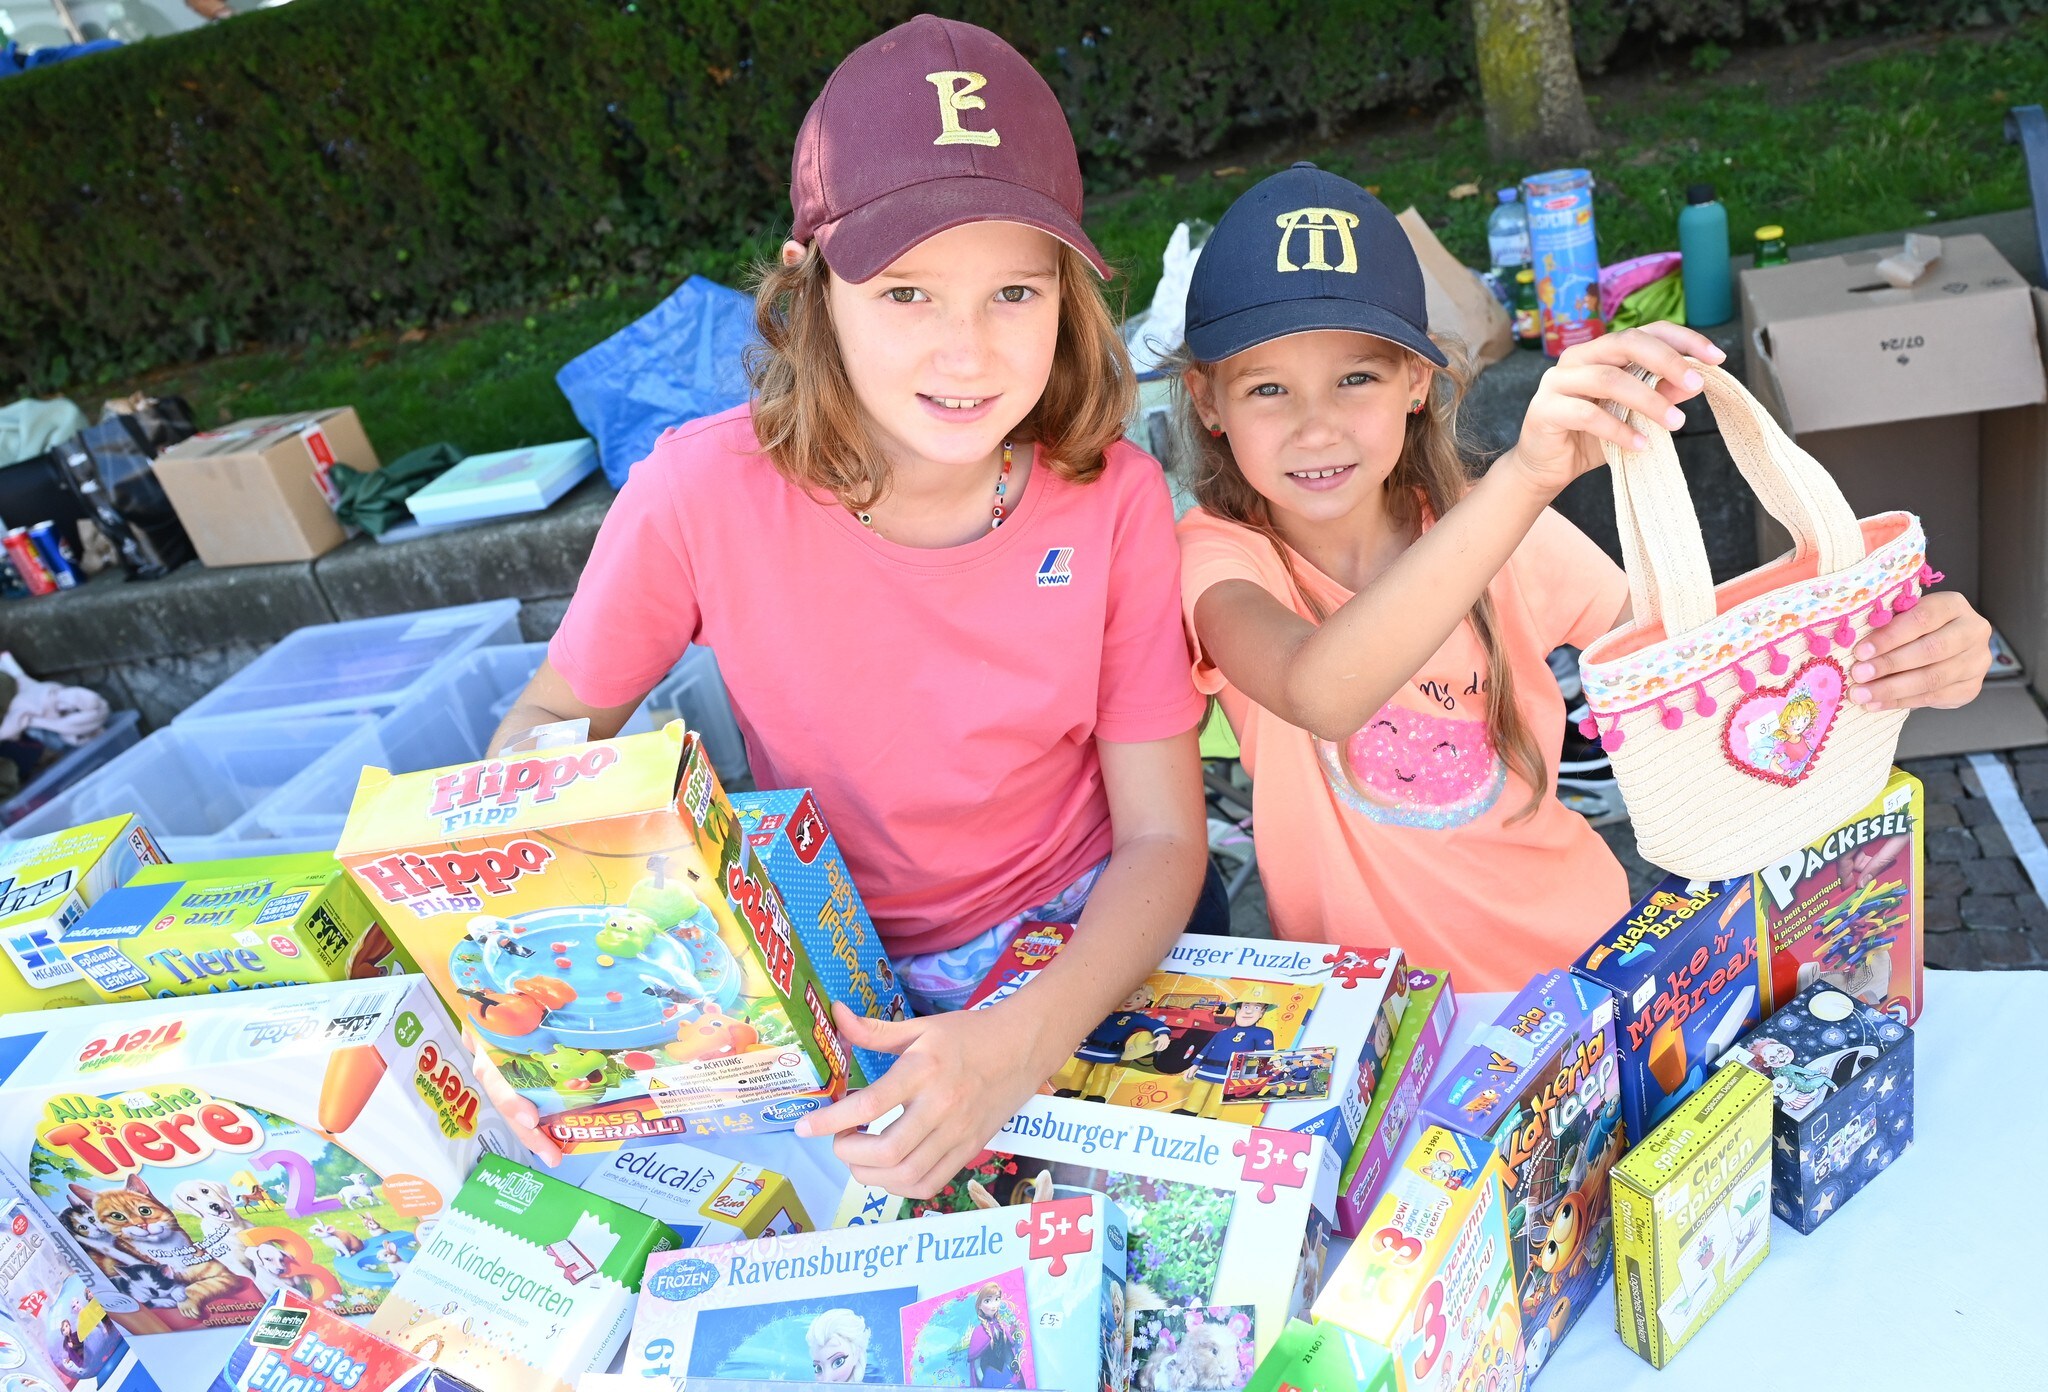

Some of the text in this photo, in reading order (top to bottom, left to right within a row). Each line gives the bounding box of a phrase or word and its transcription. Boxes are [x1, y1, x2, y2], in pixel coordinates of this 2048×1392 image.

[430, 747, 620, 816] Hippo
[444, 805, 518, 832] Flipp
[358, 840, 553, 902] Hippo
[1760, 813, 1907, 911] PACKESEL
[181, 881, 277, 910] füttern
[264, 902, 301, 916] NEUES
[267, 893, 308, 907] LERNEN
[409, 896, 482, 917] Flipp
[822, 857, 867, 948] der Käfer
[1772, 877, 1842, 930] Le petit Bourriquot
[184, 908, 237, 927] Tiere
[261, 908, 297, 923] spielend
[726, 861, 796, 1000] Hippo
[766, 887, 791, 945] Flipp
[1611, 903, 1661, 953] Make
[1647, 888, 1719, 941] Break
[1779, 914, 1808, 939] piccolo
[1807, 899, 1829, 918] Asino
[66, 925, 142, 938] Ravensburger
[273, 939, 290, 949] 3-6
[1024, 935, 1063, 945] FIREMAN
[1774, 923, 1813, 954] Pack Mule
[79, 947, 117, 967] spielend
[1020, 942, 1057, 957] SAM
[1237, 947, 1311, 970] Puzzle
[32, 962, 75, 981] MEGABLEU
[86, 958, 131, 978] NEUES
[100, 969, 142, 989] LERNEN
[145, 948, 265, 985] Tiere
[1409, 975, 1431, 989] 4+
[1572, 978, 1588, 1011] Ravensburger
[1626, 945, 1711, 1052] Make
[1671, 936, 1759, 1031] Break
[80, 1021, 183, 1062] Tiere
[398, 1017, 415, 1039] 3-4
[79, 1054, 124, 1072] meine
[703, 1057, 744, 1070] ACHTUNG:
[811, 1026, 841, 1080] SPASS
[1504, 1083, 1515, 1094] Das
[1535, 1027, 1566, 1059] Käfer-Rennen
[418, 1045, 478, 1134] Tiere
[668, 1086, 713, 1098] ATTENTION:
[748, 1070, 795, 1084] AVVERTENZA:
[49, 1087, 202, 1123] Alle meine
[415, 1073, 460, 1138] Alle meine
[766, 1099, 816, 1116] Hasbro
[1499, 1029, 1605, 1194] Kakerla
[1700, 1075, 1740, 1115] Logisches Denken
[554, 1119, 681, 1141] ÜBERALL!
[563, 1111, 637, 1127] SPASS
[689, 1118, 712, 1126] ALTER
[696, 1125, 717, 1135] 4+
[43, 1104, 254, 1175] Tiere
[1001, 1111, 1219, 1166] ensburger Puzzle
[1252, 1138, 1288, 1170] 3+
[1424, 1136, 1440, 1155] 23 390
[1649, 1126, 1676, 1154] Clever
[1653, 1127, 1695, 1172] spielen
[615, 1151, 715, 1193] educal toy
[1692, 1127, 1743, 1187] Clever
[603, 1171, 691, 1205] Lerne das Zählen Learn to count
[1516, 1182, 1524, 1198] Das
[1676, 1137, 1753, 1231] spielen
[1691, 1157, 1754, 1232] Logisches Denken
[714, 1195, 745, 1208] Bino
[1038, 1211, 1072, 1246] 5+
[1413, 1207, 1432, 1237] vince!
[1424, 1226, 1432, 1239] op
[1429, 1211, 1441, 1228] een
[1622, 1199, 1634, 1243] spielen
[1634, 1216, 1645, 1247] Clever
[148, 1223, 231, 1259] Wie viele Tierkinder
[182, 1243, 231, 1267] siehst du?
[728, 1225, 1003, 1286] Ravensburger Puzzle
[1372, 1228, 1423, 1265] 3
[427, 1231, 574, 1318] Im Kindergarten
[1413, 1179, 1492, 1380] 3 gewinnt!
[1444, 1225, 1483, 1303] gagnant!
[412, 1265, 529, 1328] Lernkompetenzen kindgemäß anbahnen
[655, 1272, 712, 1292] FROZEN
[1447, 1256, 1477, 1318] vince!
[25, 1293, 43, 1310] 72
[1451, 1307, 1463, 1328] op
[1459, 1272, 1480, 1310] een
[1629, 1272, 1647, 1343] Logisches Denken
[256, 1325, 297, 1338] Schulpuzzle
[281, 1315, 305, 1325] erstes
[592, 1308, 627, 1361] Kindergarten
[293, 1332, 366, 1389] Erstes
[1302, 1340, 1323, 1364] 23 160
